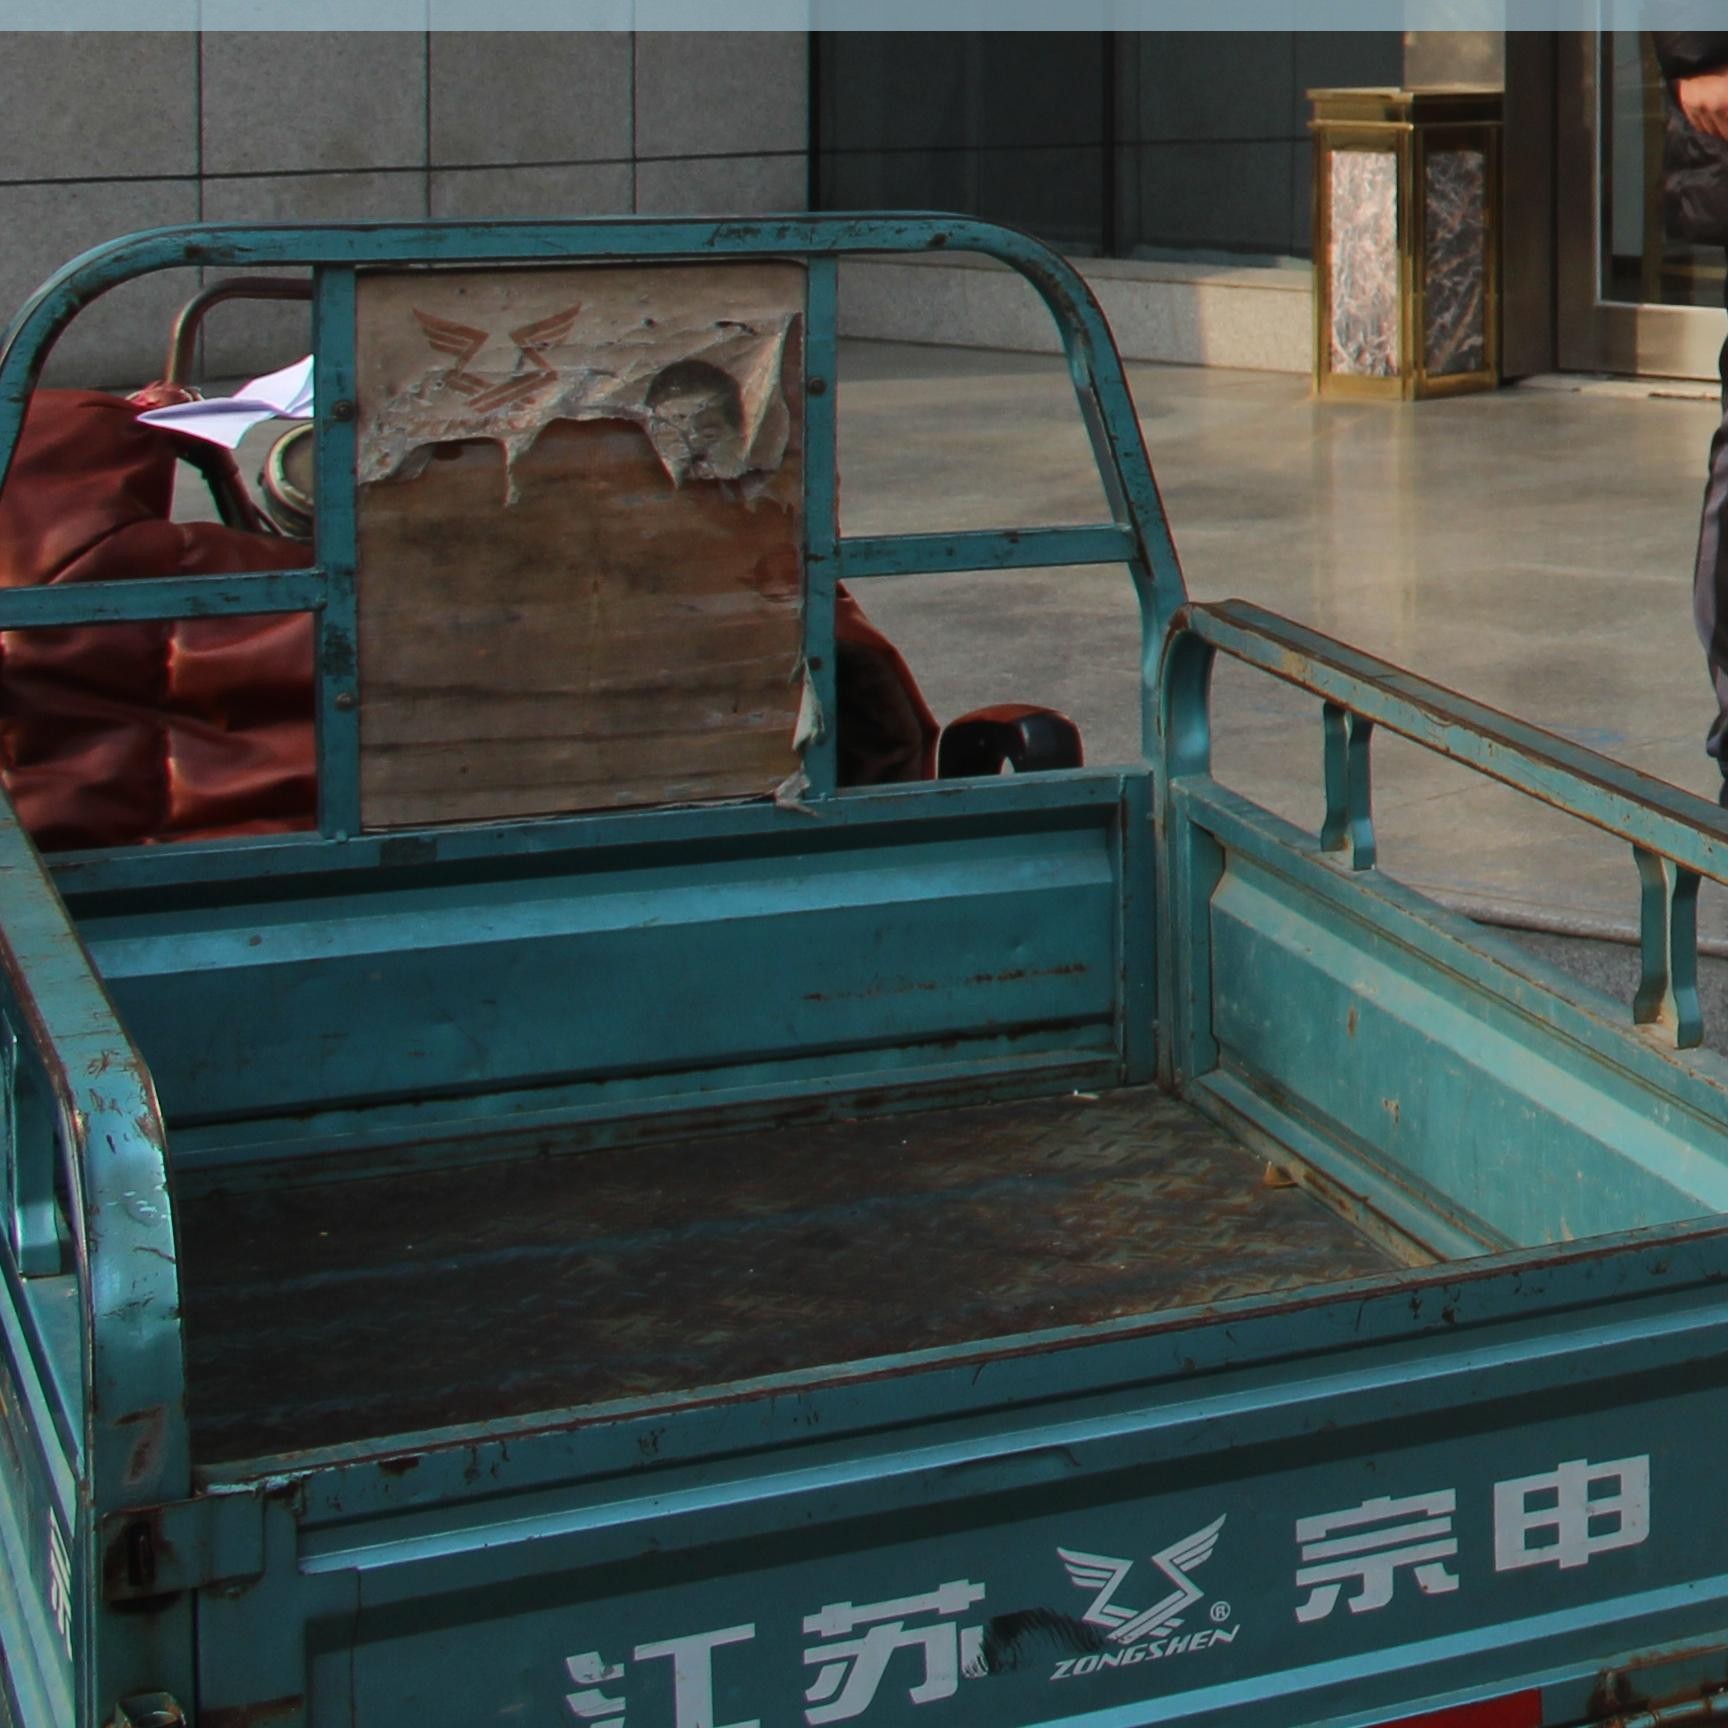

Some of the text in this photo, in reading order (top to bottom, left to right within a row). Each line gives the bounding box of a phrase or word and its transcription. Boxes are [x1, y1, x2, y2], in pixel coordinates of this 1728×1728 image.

[565, 1453, 1651, 1728] 江苏 宗申
[1048, 1623, 1240, 1680] ZONGSHEN
